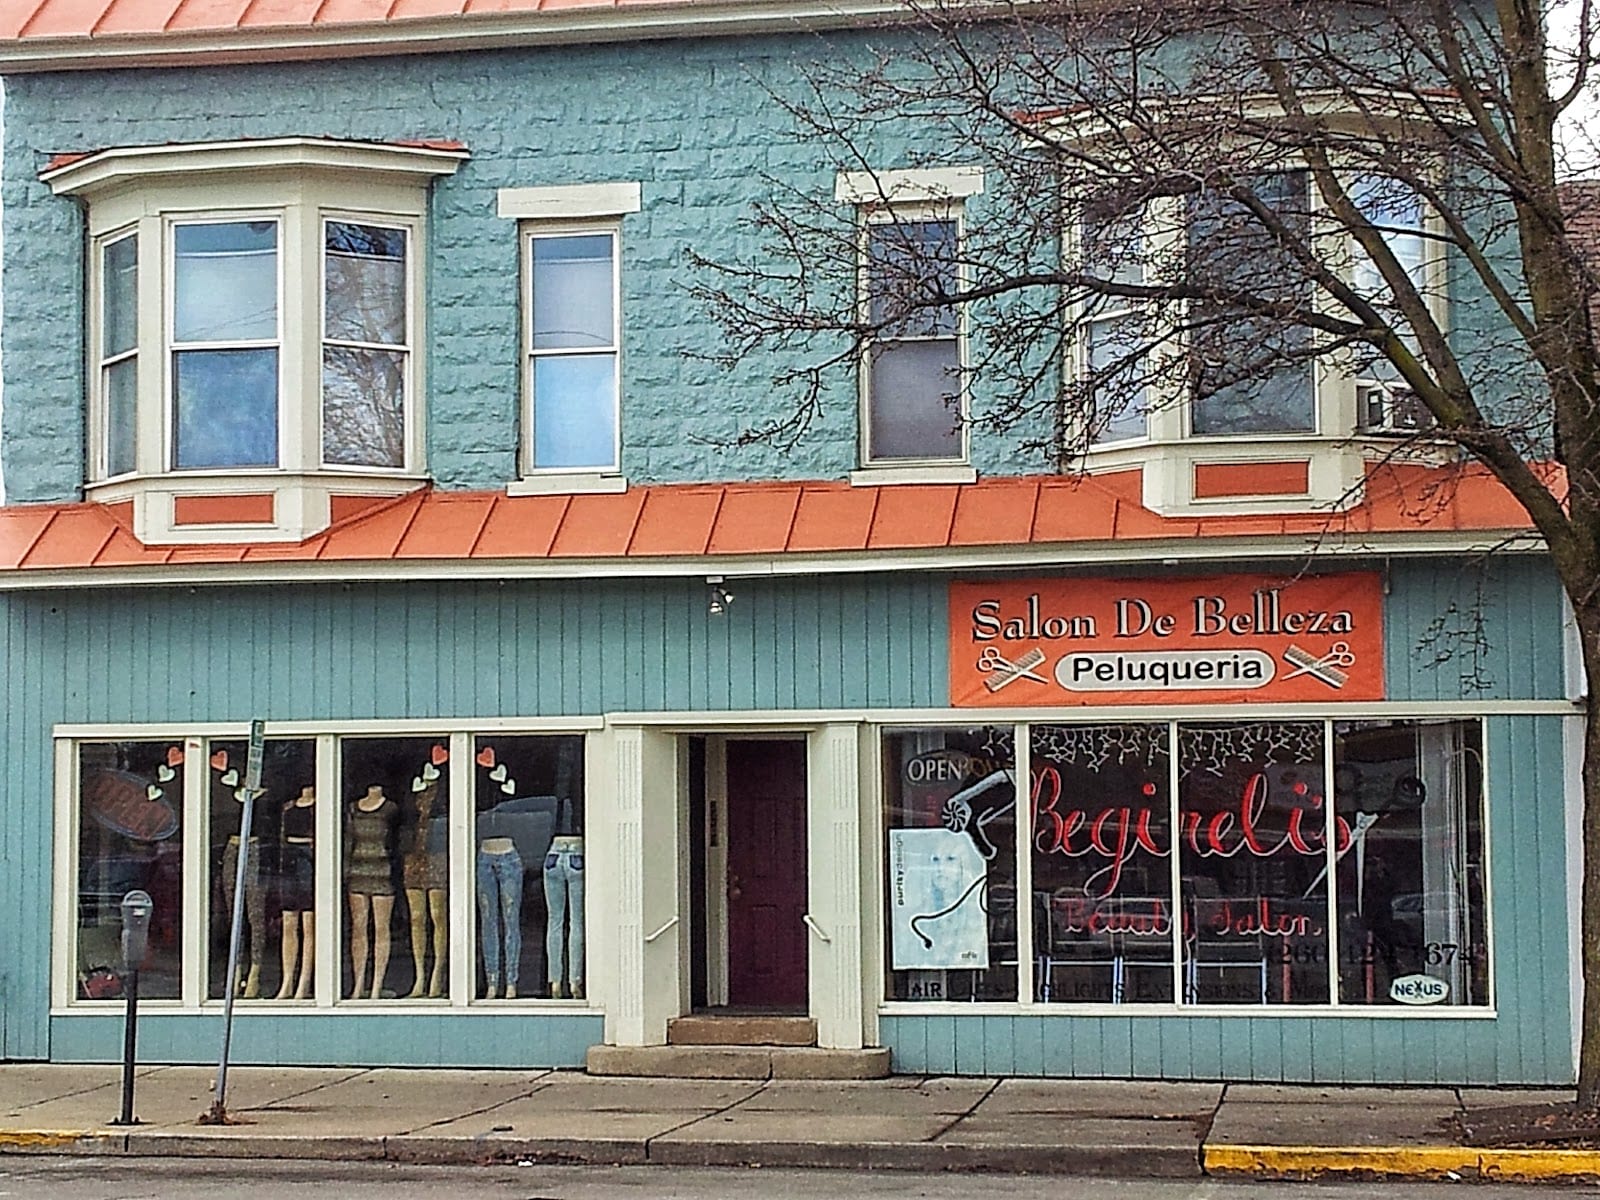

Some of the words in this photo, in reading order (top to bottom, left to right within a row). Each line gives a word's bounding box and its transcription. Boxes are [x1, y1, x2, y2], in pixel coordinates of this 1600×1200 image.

[971, 593, 1098, 642] Salon
[1114, 597, 1176, 638] De
[1192, 588, 1356, 637] Belleza
[1072, 655, 1263, 689] Peluqueria
[907, 757, 963, 783] OPEN
[1395, 979, 1443, 998] NEXUS
